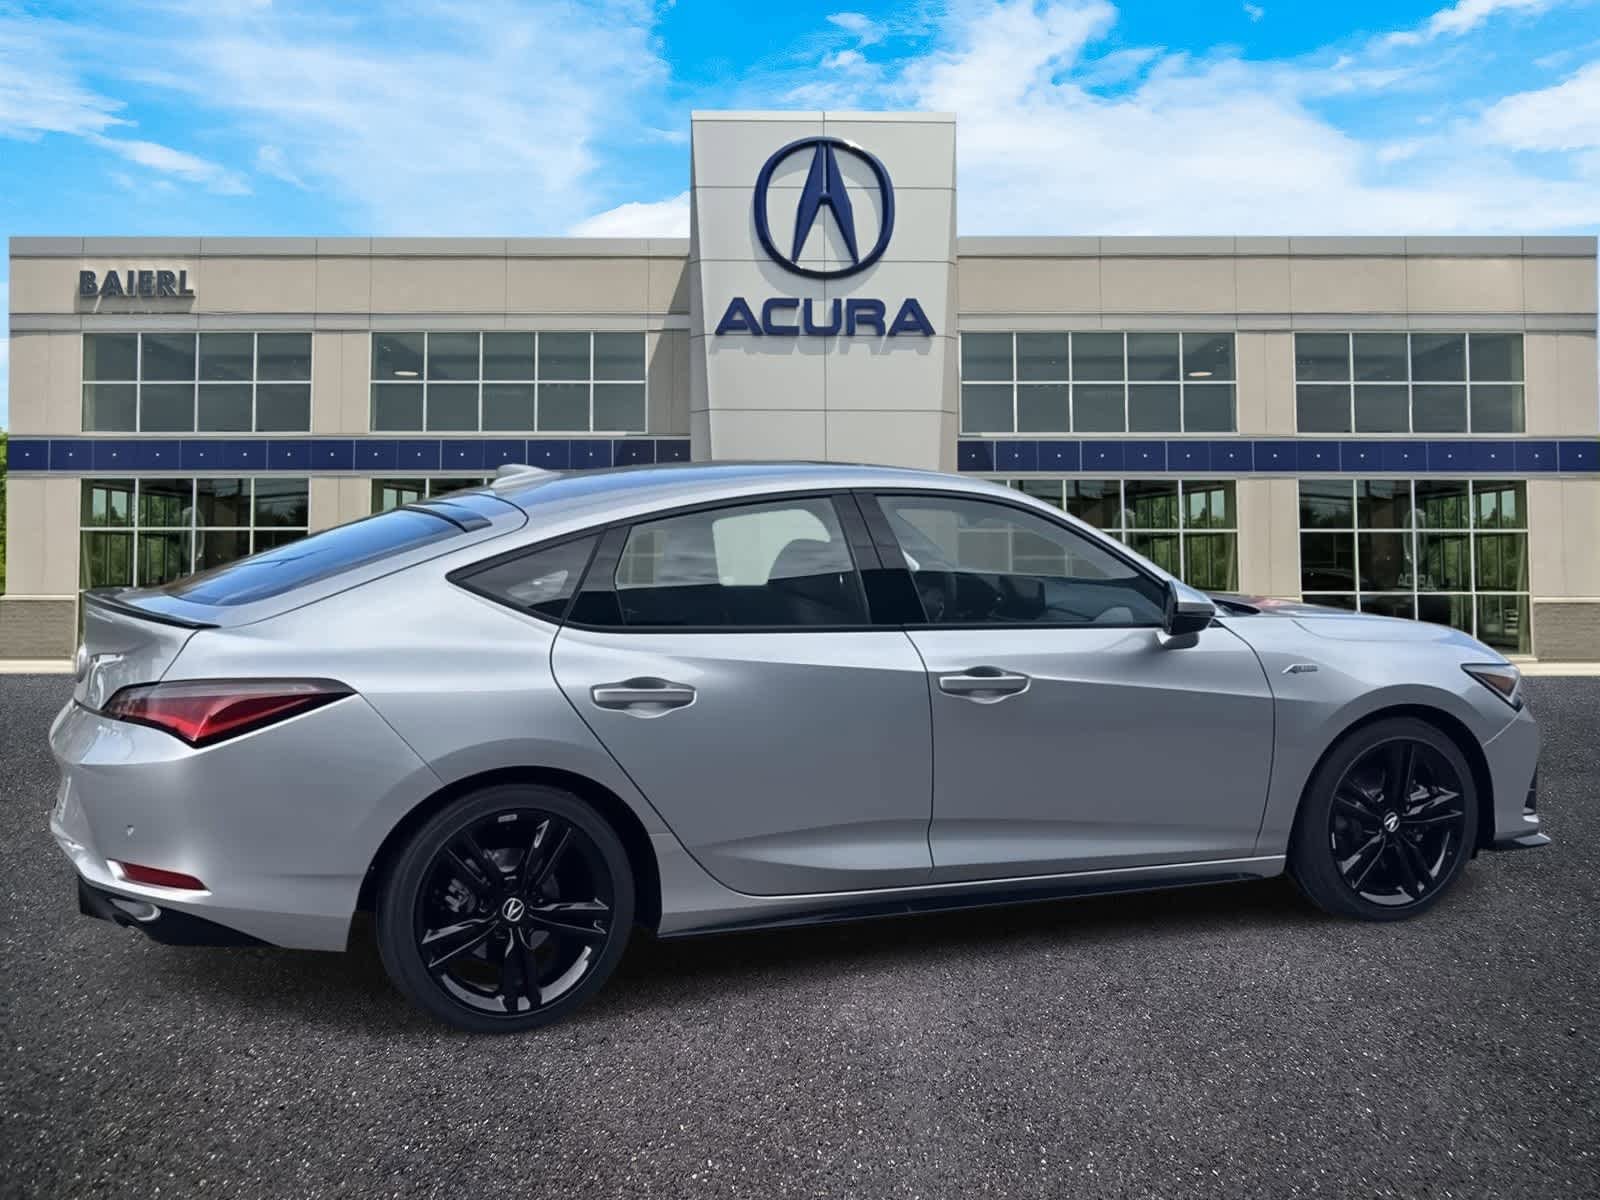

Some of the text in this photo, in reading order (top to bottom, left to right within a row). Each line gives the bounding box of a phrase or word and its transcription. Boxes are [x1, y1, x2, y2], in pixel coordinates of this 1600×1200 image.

[79, 269, 195, 297] BAIERL
[714, 297, 937, 337] ACURA
[1397, 573, 1434, 588] ACRA
